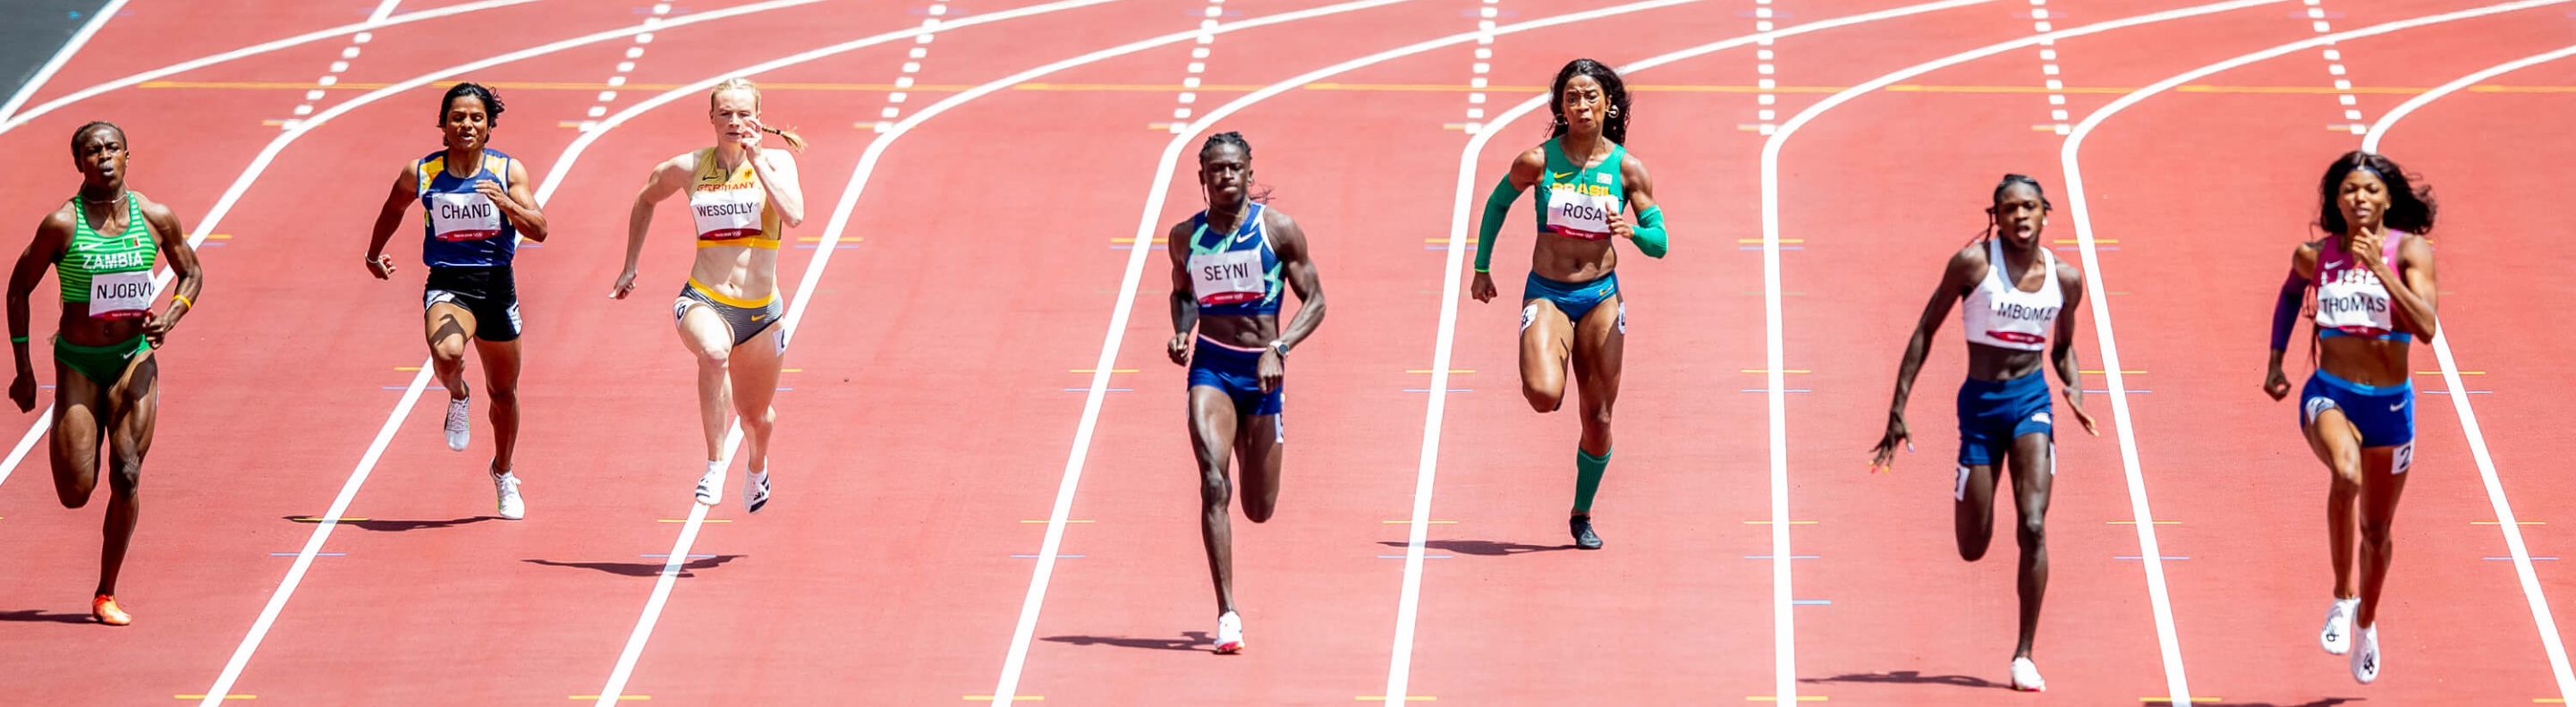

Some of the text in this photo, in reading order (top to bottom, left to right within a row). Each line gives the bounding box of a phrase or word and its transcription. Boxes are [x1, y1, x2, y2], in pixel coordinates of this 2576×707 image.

[442, 203, 491, 219] CHAND
[697, 202, 753, 217] WESSOLLY
[1563, 202, 1602, 221] ROSA
[82, 251, 143, 269] ZAMBIA
[1204, 263, 1249, 281] SEYNI
[2321, 296, 2385, 312] THOMAS
[2399, 445, 2411, 470] 2
